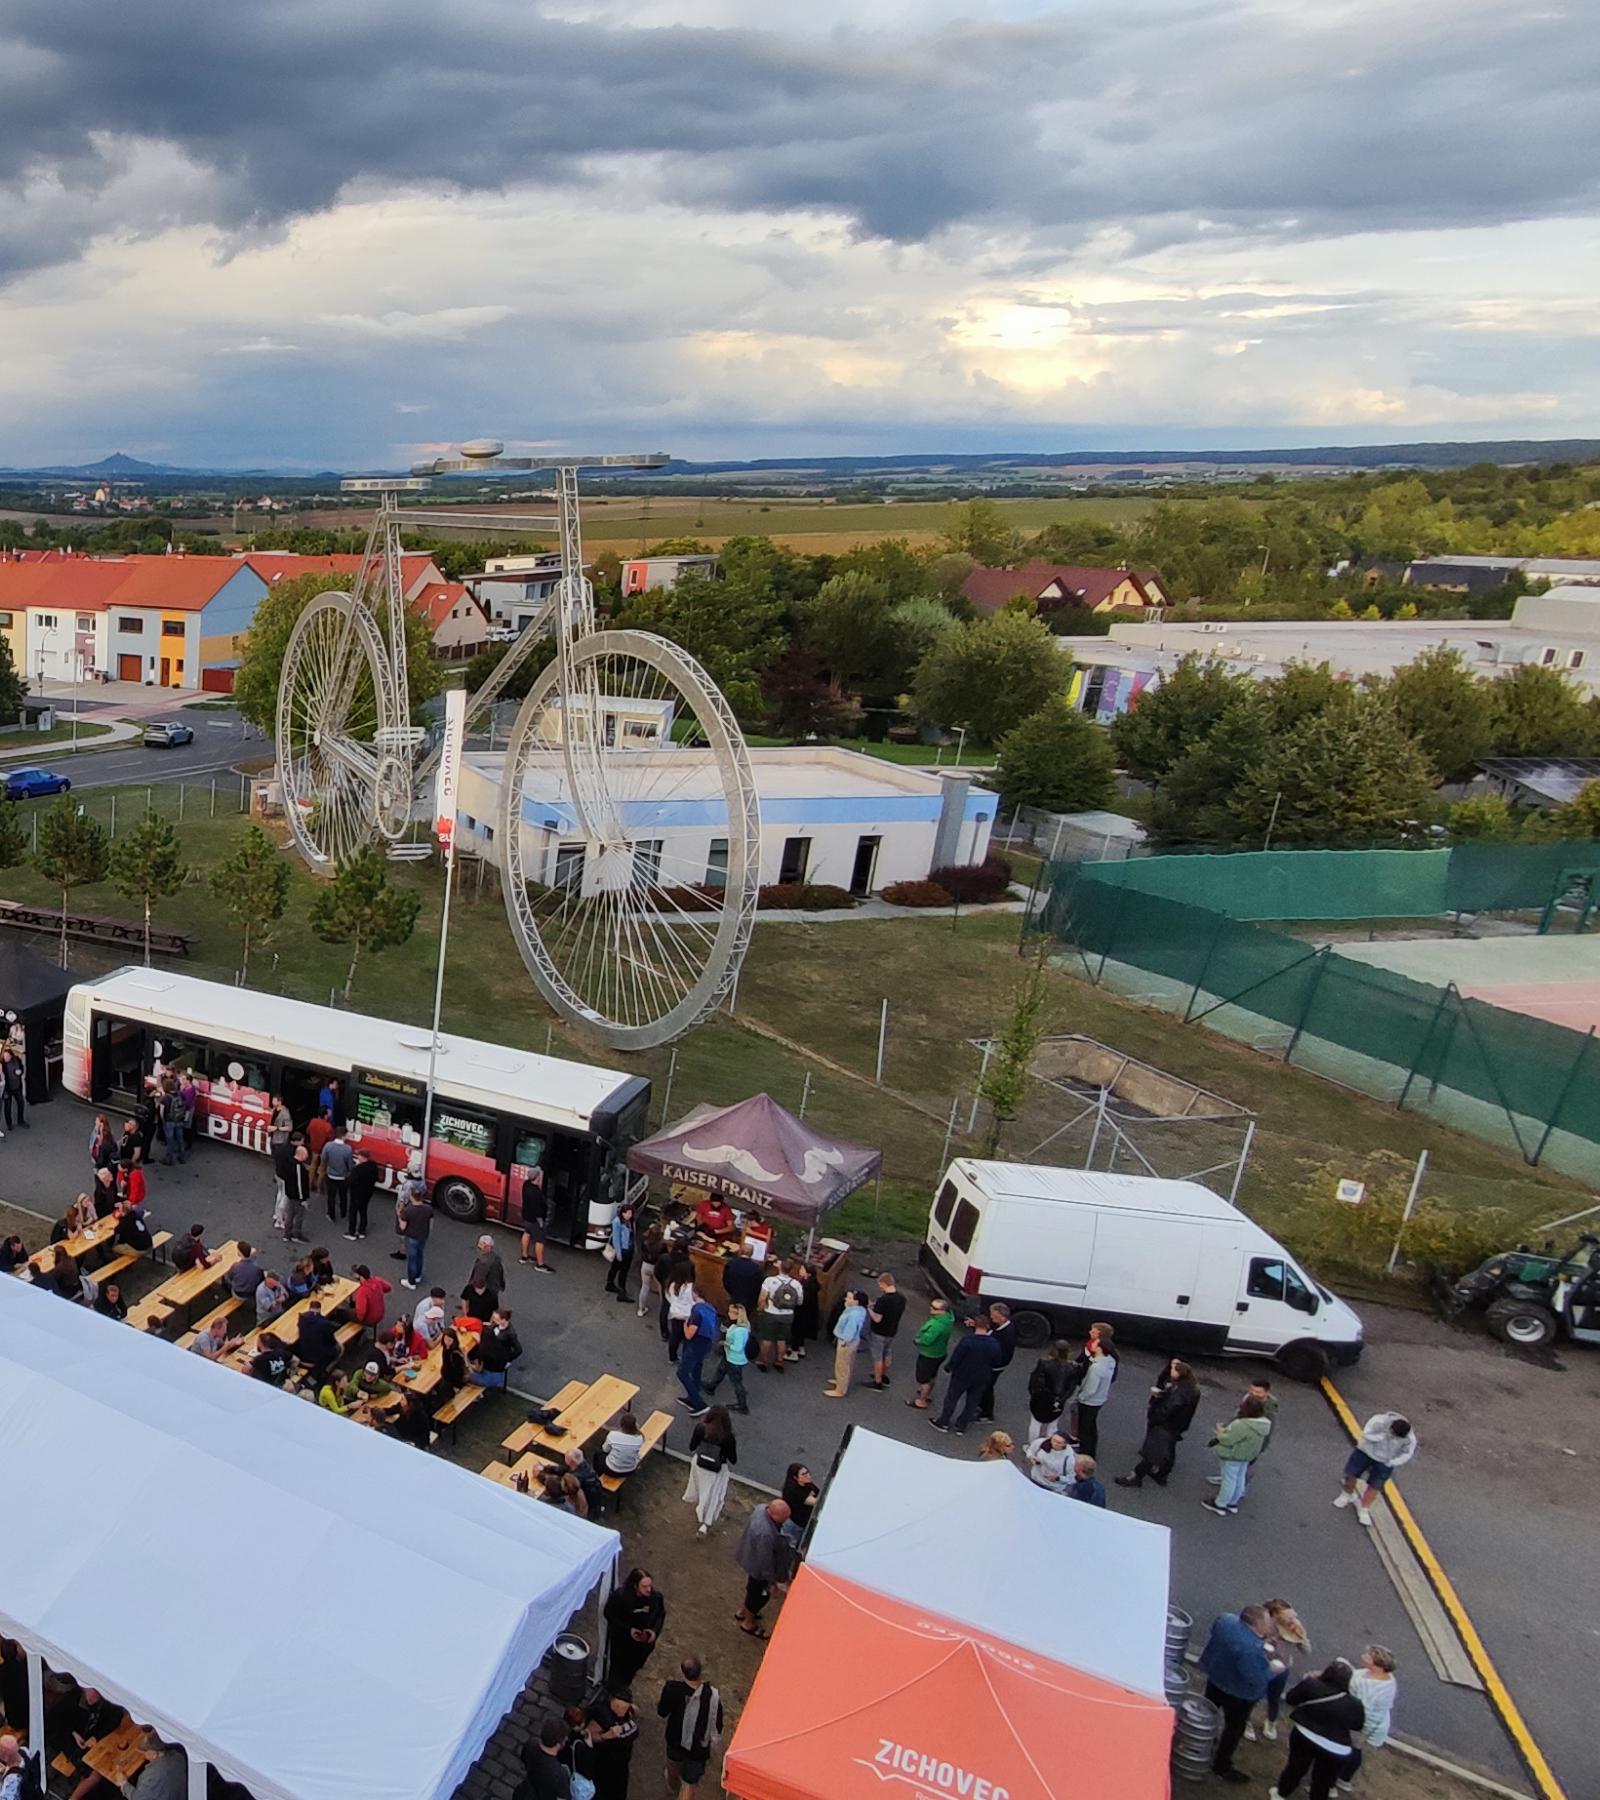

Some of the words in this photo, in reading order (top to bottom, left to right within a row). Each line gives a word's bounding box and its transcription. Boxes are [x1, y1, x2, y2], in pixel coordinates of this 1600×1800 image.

[440, 1114, 484, 1135] ZICHOVEC
[662, 1163, 718, 1189] KAISER
[720, 1177, 773, 1210] FRANZ
[874, 1738, 1010, 1800] ZICHOVEC
